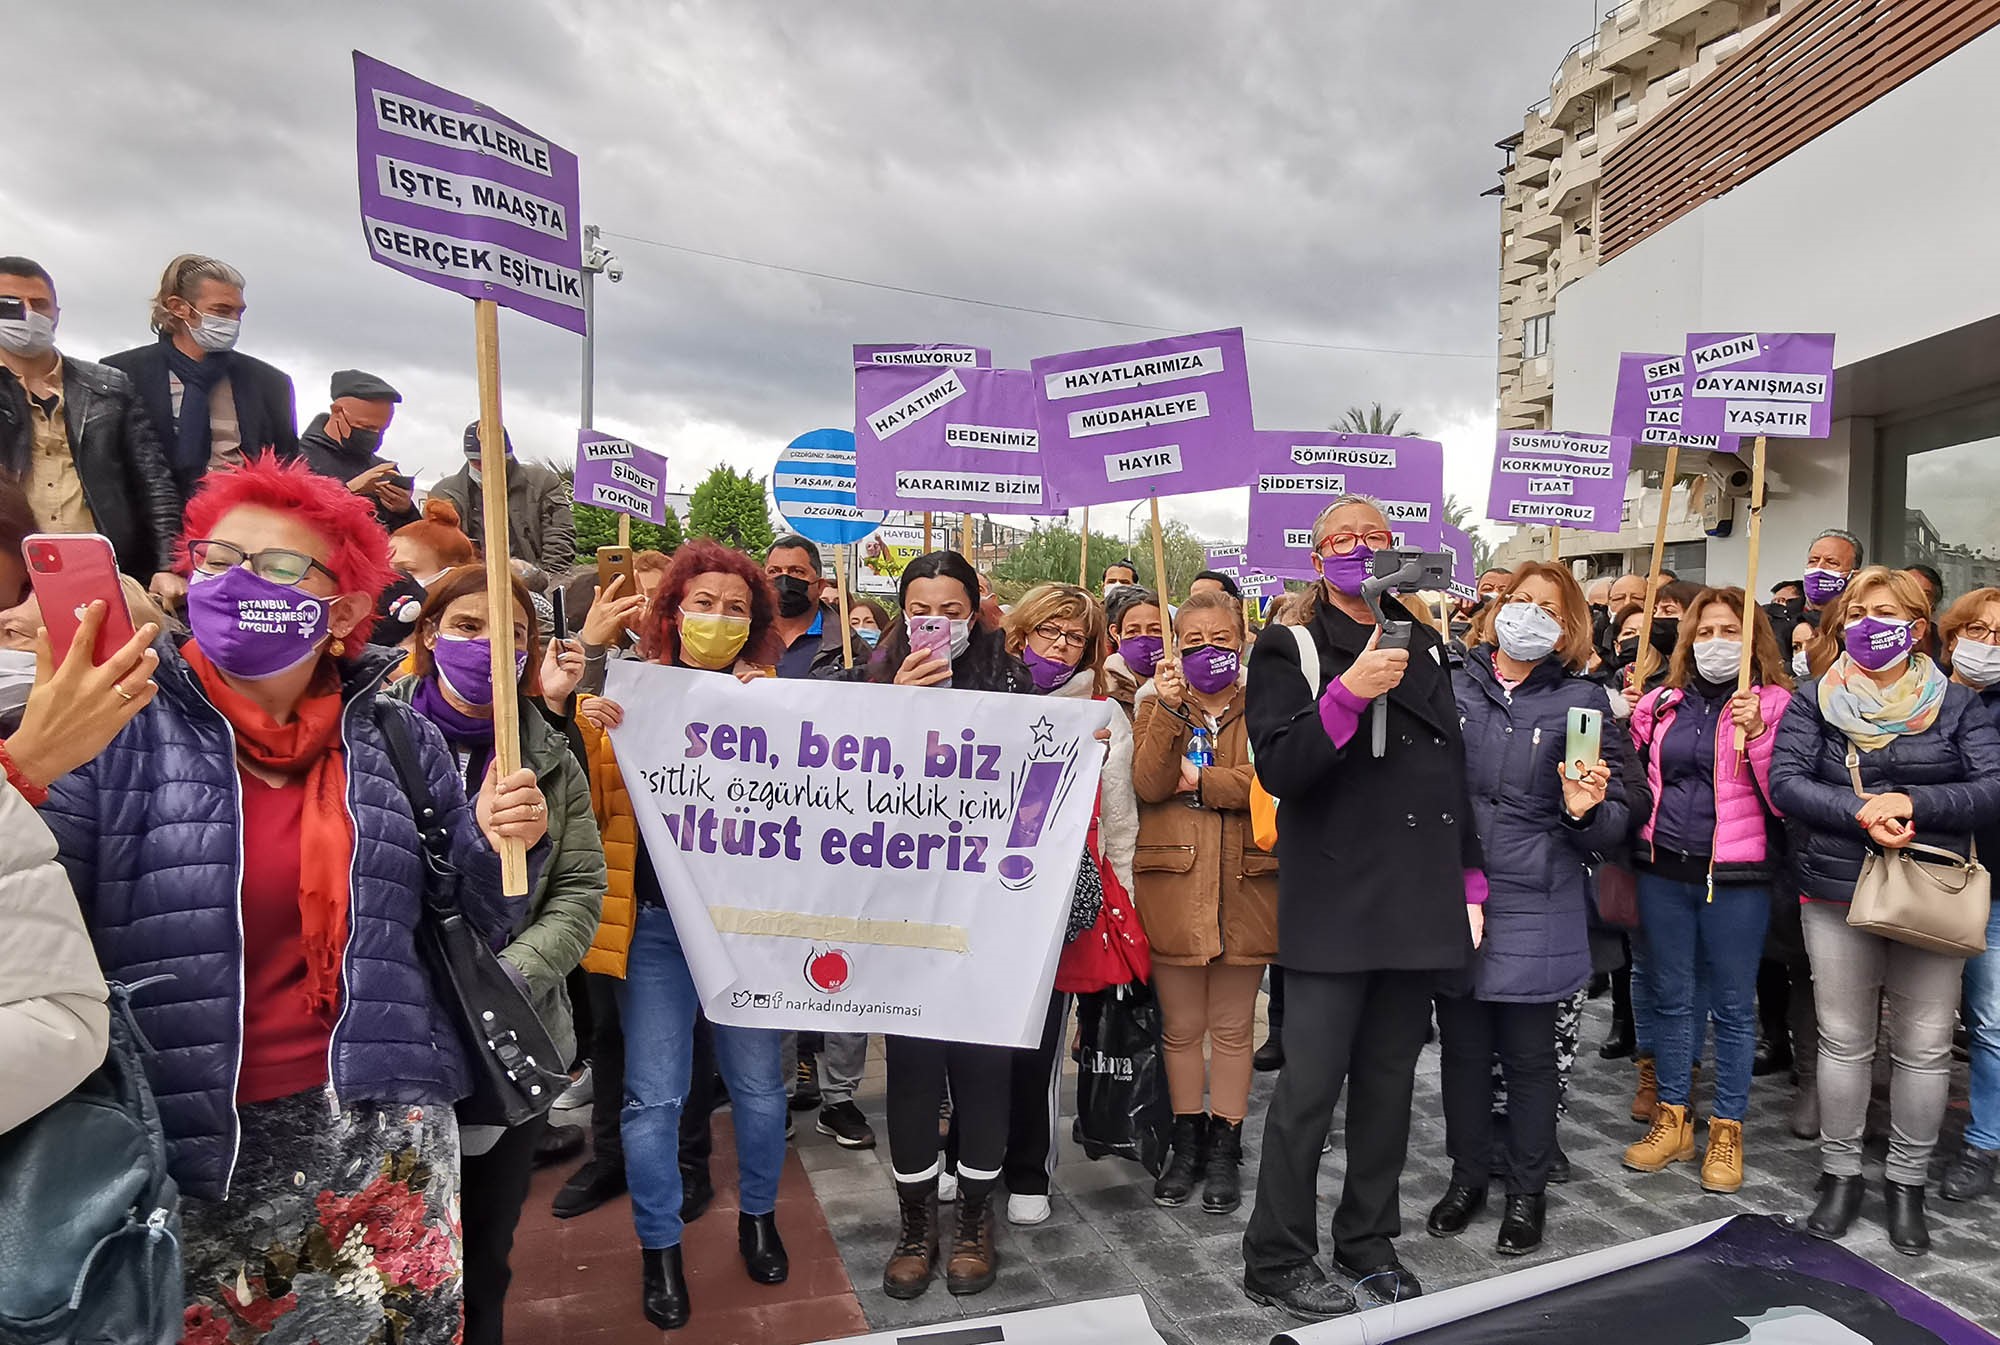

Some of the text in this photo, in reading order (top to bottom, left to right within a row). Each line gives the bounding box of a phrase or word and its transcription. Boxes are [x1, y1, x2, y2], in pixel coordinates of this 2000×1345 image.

[379, 97, 549, 171] ERKEKLERLE
[389, 160, 564, 233] İŞTE, MAAŞTA
[374, 226, 581, 298] GERÇEK EŞİTLİK
[875, 352, 973, 365] SUSMUYORUZ
[1695, 339, 1755, 365] KADIN
[1064, 355, 1204, 389] HAYATLARIMIZA
[1647, 362, 1681, 379] SEN
[1650, 386, 1684, 402] UTA
[1695, 378, 1824, 395] DAYANIŞMASI
[875, 379, 958, 433] HAYATIMIZ
[1081, 399, 1198, 428] MÜDAHALEYE
[1647, 410, 1680, 423] TAC
[1728, 410, 1808, 426] YAŞATIR
[947, 429, 1037, 447] BEDENİMİZ
[1511, 436, 1609, 455] SUSMUYORUZ
[1646, 429, 1718, 446] UTANSIN
[588, 443, 630, 456] HAKLI
[1293, 449, 1393, 466] SÖMÜRÜSÜZ,
[1118, 453, 1172, 472] HAYIR
[1502, 460, 1611, 476] KORKMUYORUZ
[613, 465, 656, 491] ŞİDDET
[794, 477, 834, 488] YAŞAM,
[898, 478, 1041, 495] KARARIMIZ BİZİM
[1260, 475, 1344, 492] ŞİDDETSİZ,
[1530, 480, 1571, 492] İTAAT
[597, 487, 649, 514] YOKTUR
[803, 506, 865, 518] ÖZGÜRLÜK
[1387, 505, 1428, 519] AŞAM
[1511, 504, 1593, 519] ETMİYORUZ
[883, 529, 943, 541] HAYBULNS
[1212, 547, 1241, 558] ERKEK
[1449, 581, 1476, 598] DALET
[684, 720, 1002, 781] sen, ben, biz
[727, 774, 855, 815] özgürlük
[867, 779, 952, 820] laiklik
[820, 820, 989, 873] ederiz
